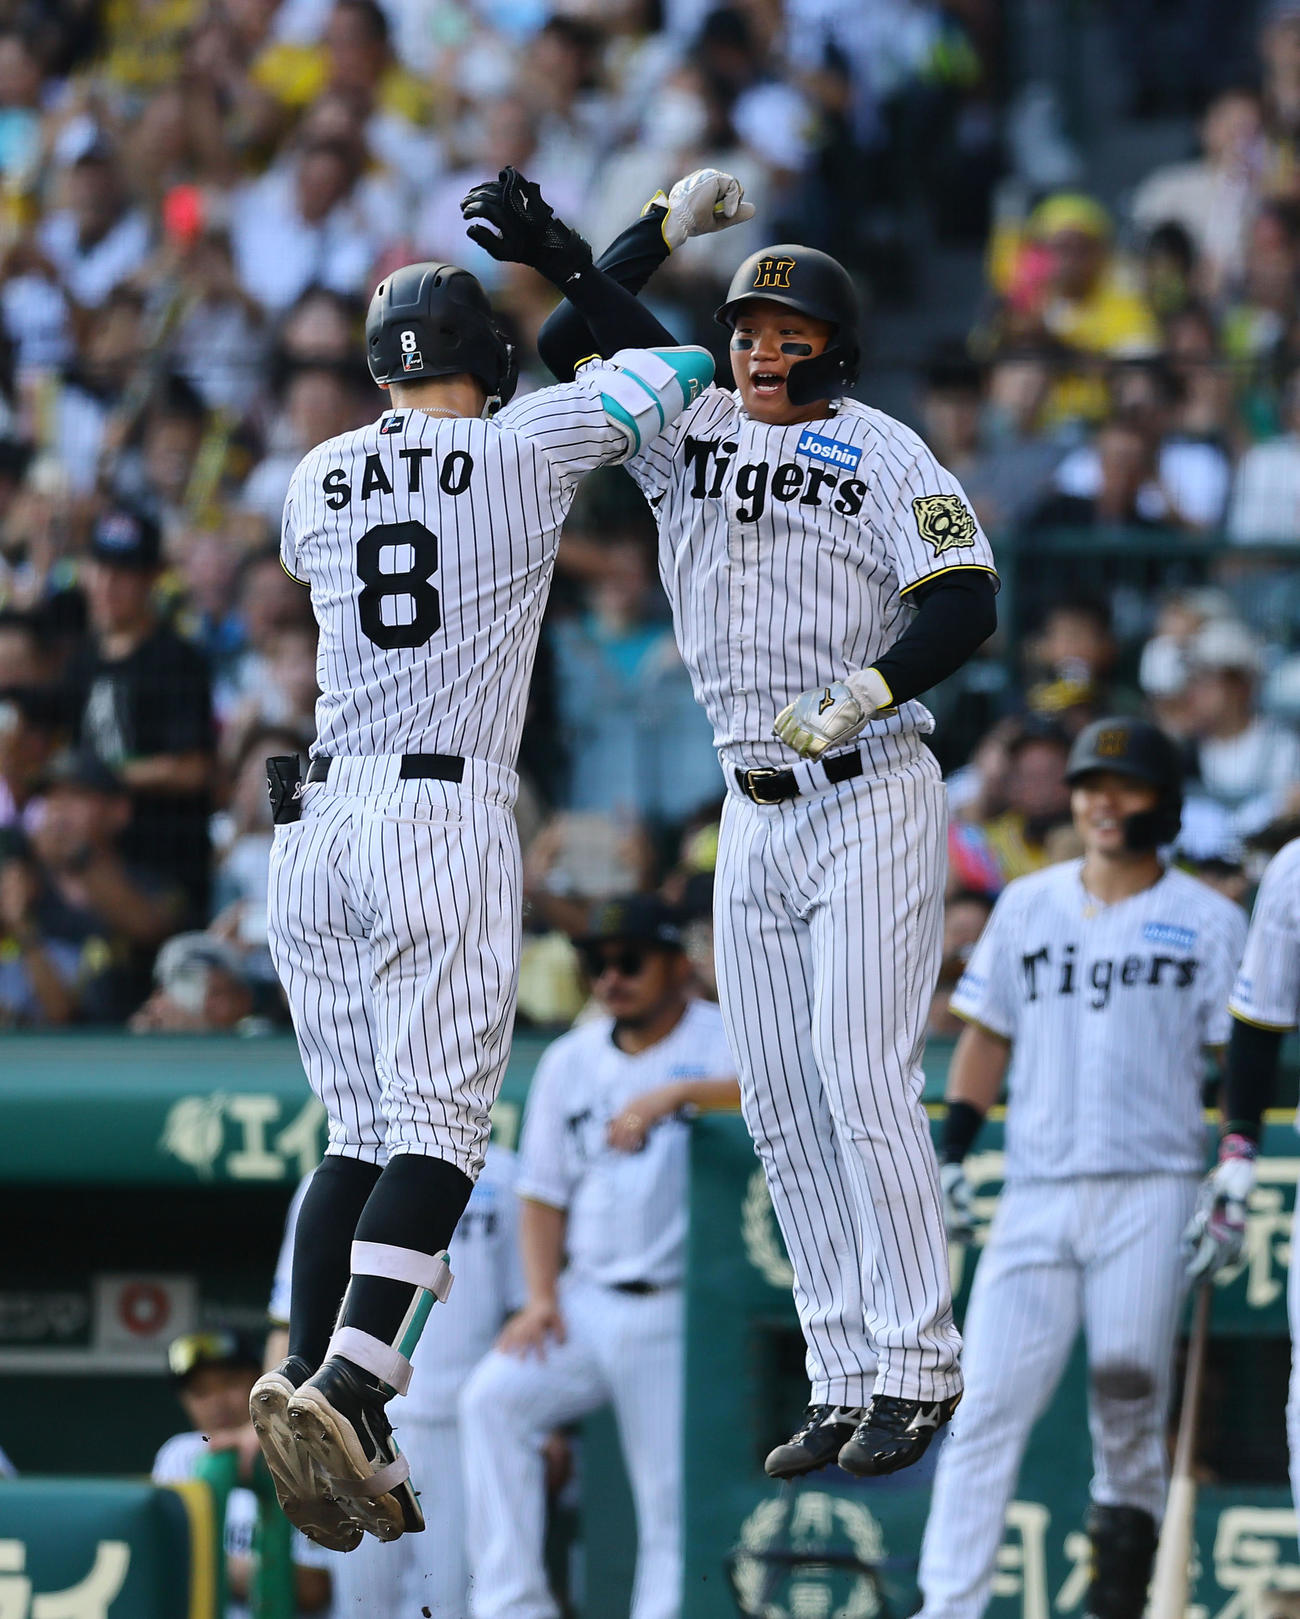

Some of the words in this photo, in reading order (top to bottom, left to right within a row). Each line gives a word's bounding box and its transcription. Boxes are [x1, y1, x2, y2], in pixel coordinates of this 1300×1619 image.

[400, 330, 417, 353] 8
[322, 448, 474, 511] SATO
[684, 434, 868, 524] Tigers
[798, 435, 859, 468] Joshin
[356, 520, 441, 650] 8
[1023, 945, 1199, 1009] Tigers
